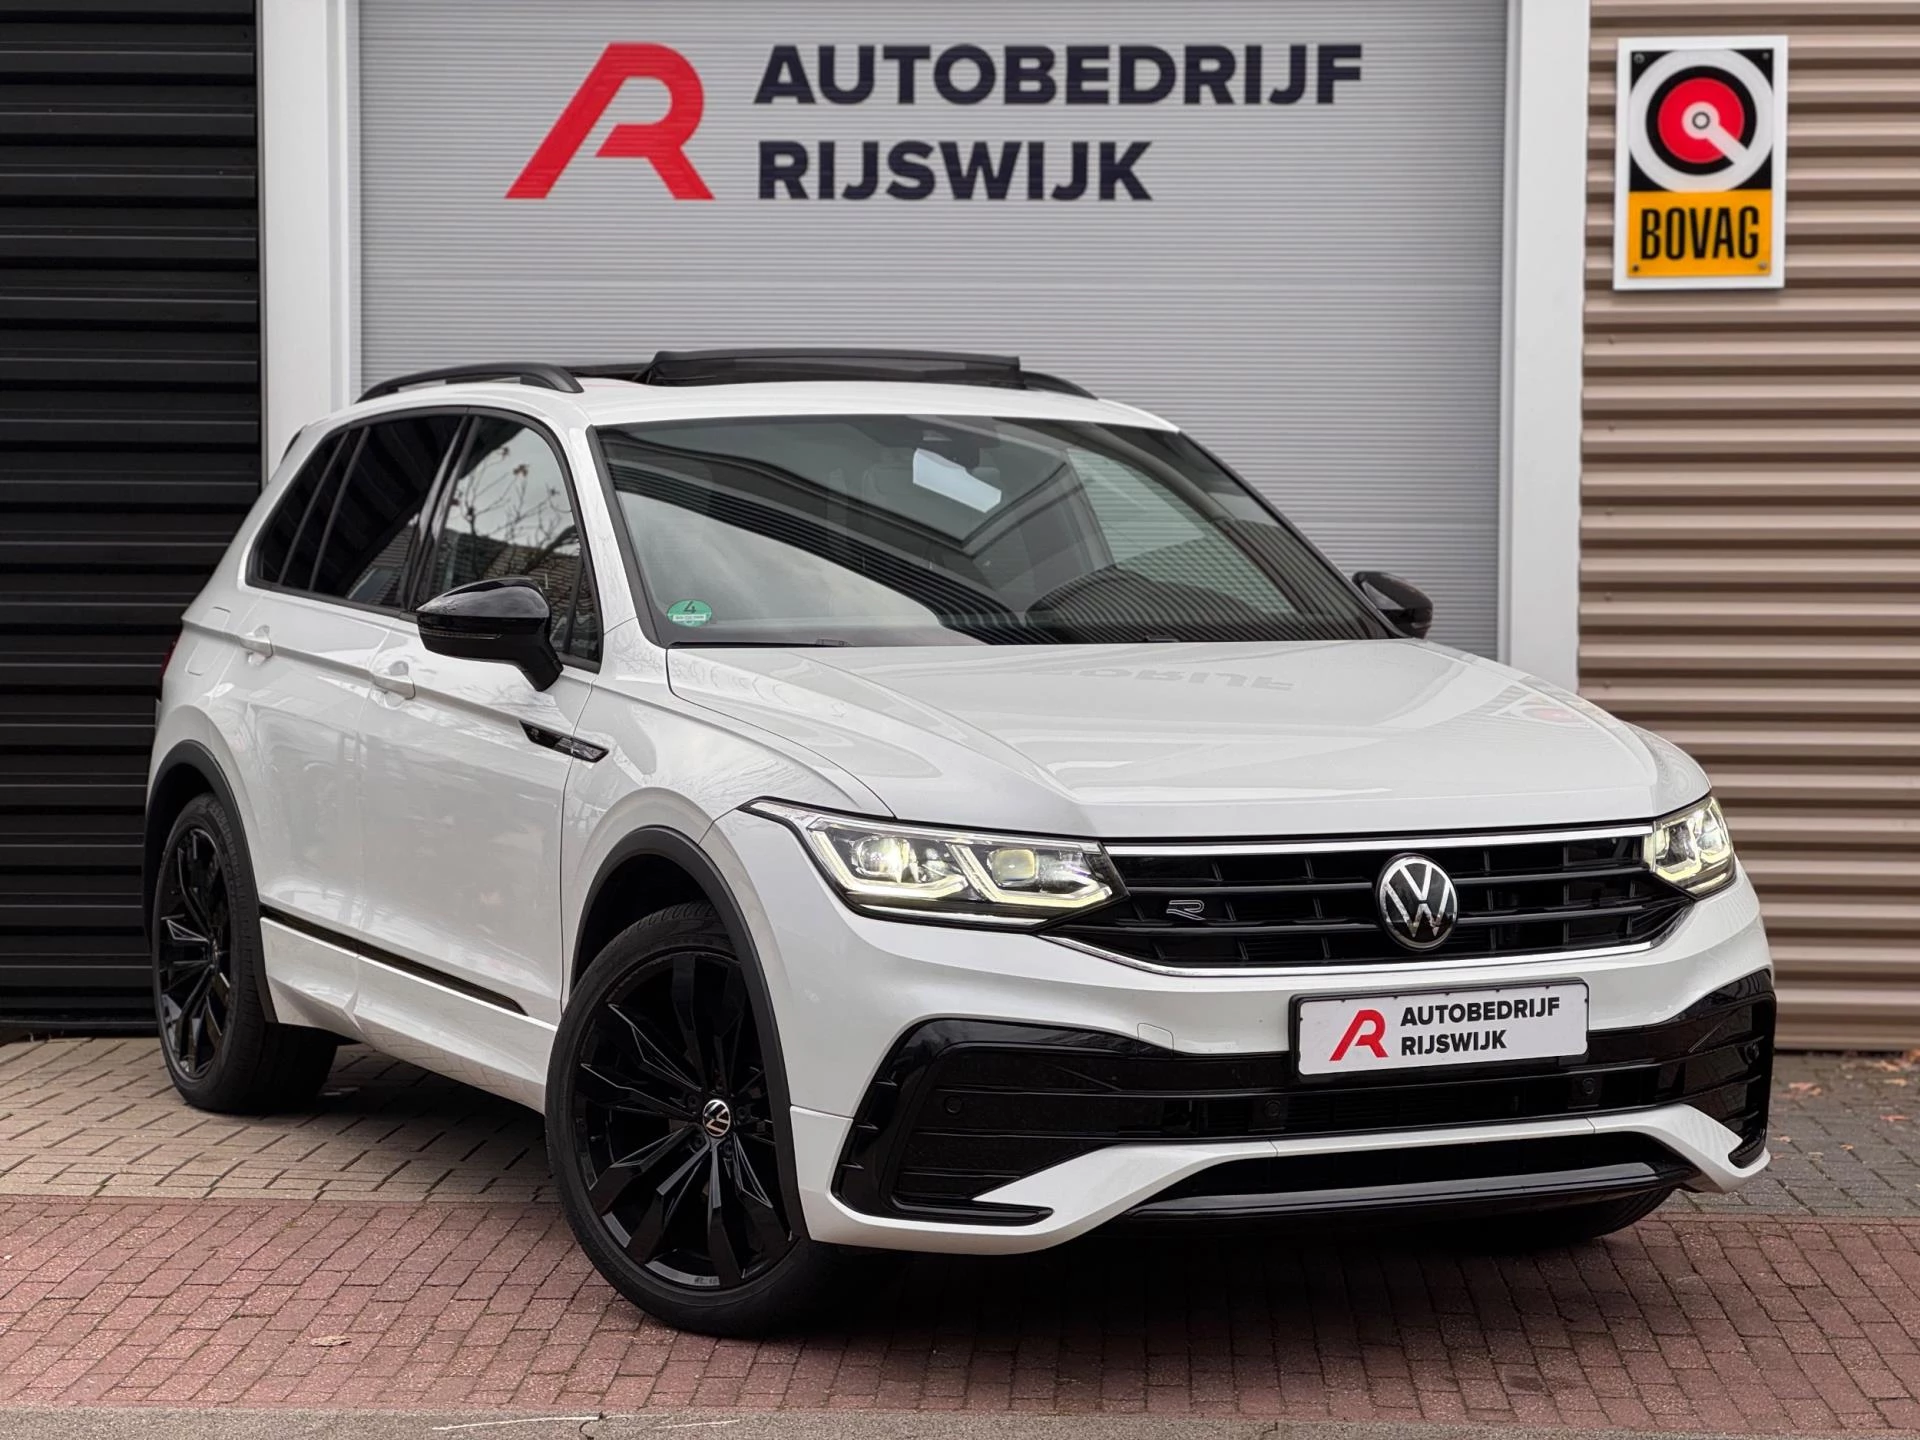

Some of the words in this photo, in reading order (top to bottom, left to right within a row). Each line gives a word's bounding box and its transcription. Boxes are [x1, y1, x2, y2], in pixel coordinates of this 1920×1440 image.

[754, 44, 1362, 105] AUTOBEDRIJF
[759, 141, 1153, 201] RIJSWIJK
[1640, 206, 1759, 260] BOVAG
[683, 600, 697, 614] 4
[1400, 997, 1560, 1027] AUTOBEDRIJF
[1401, 1030, 1507, 1056] RIJSWIJK
